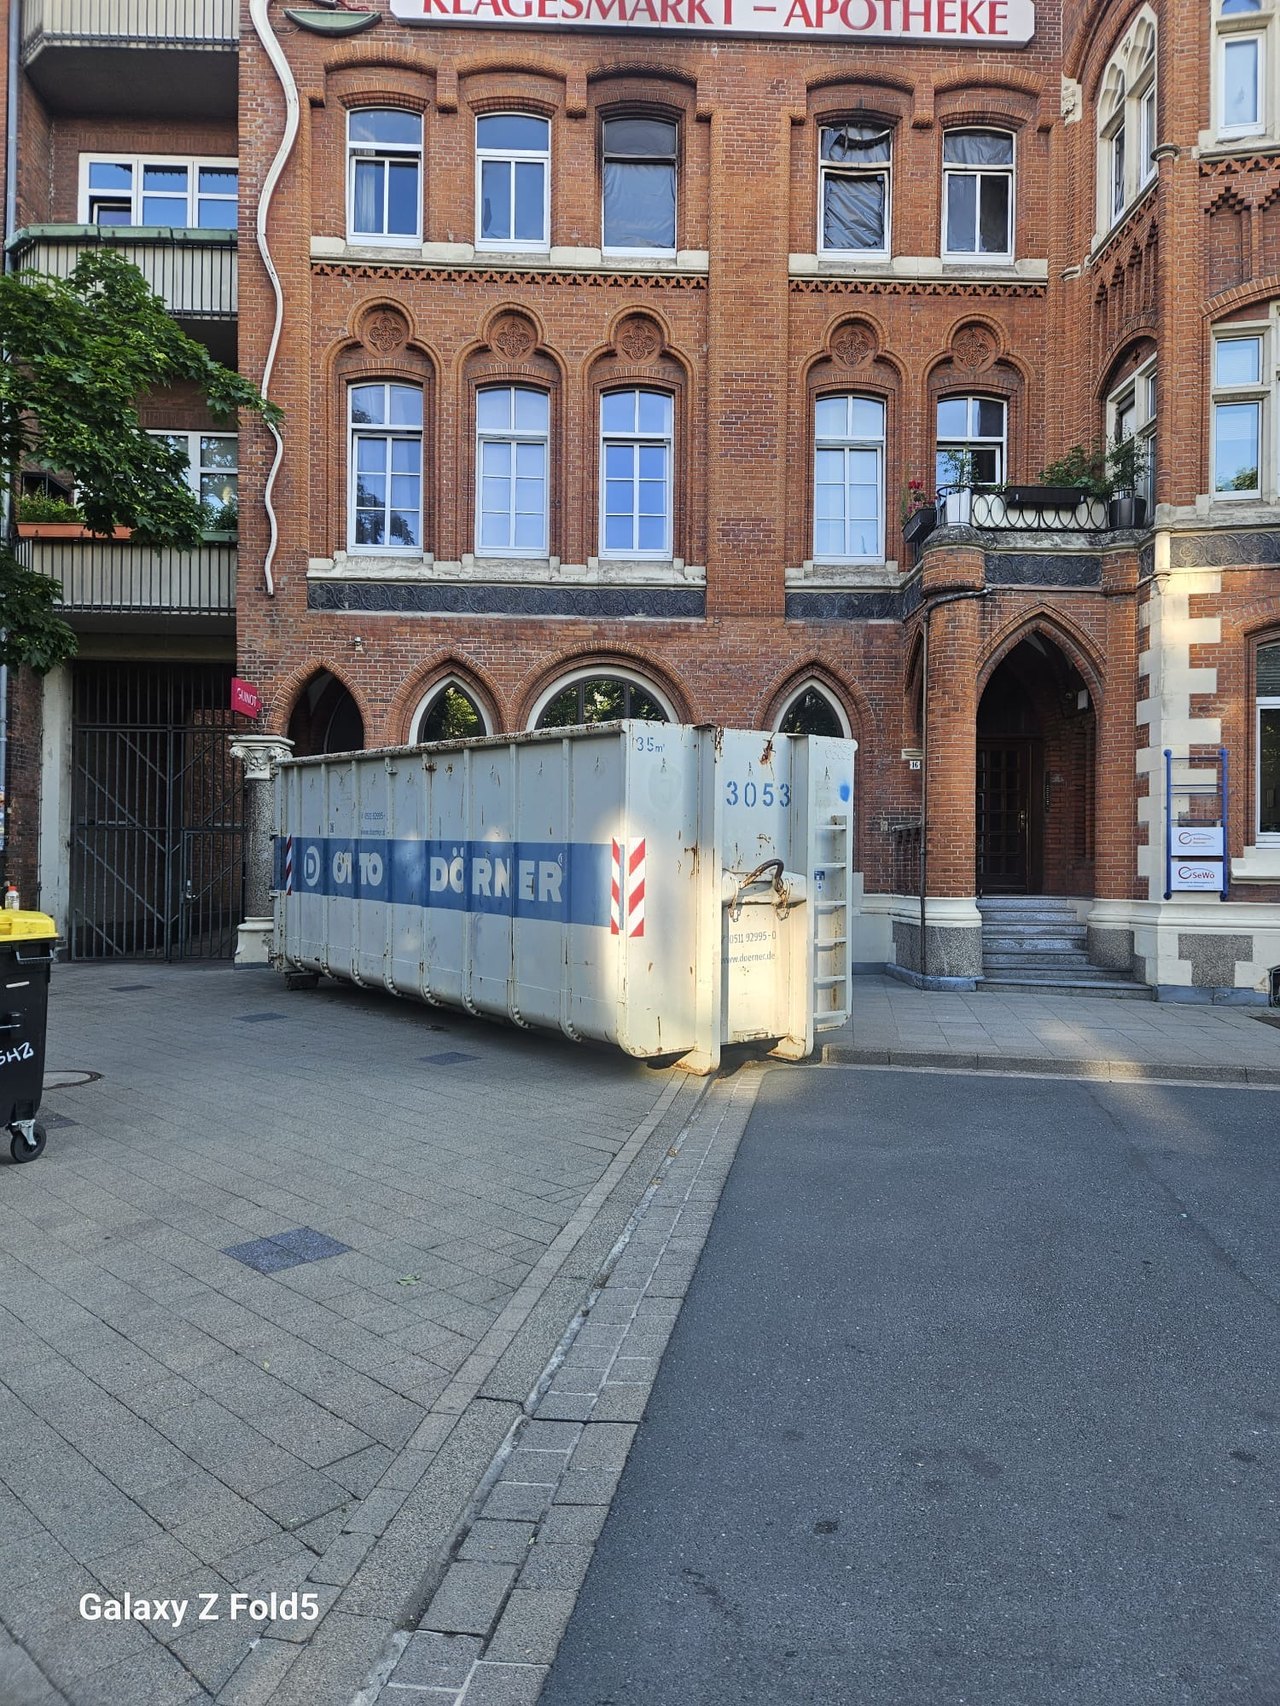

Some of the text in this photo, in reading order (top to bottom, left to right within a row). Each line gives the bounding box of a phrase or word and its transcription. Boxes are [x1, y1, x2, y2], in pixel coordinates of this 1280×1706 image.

[783, 0, 1009, 35] APOTHEKE
[911, 761, 919, 769] 16
[726, 780, 790, 808] 3053
[333, 851, 383, 887] OTTO
[430, 847, 562, 903] DÖRNER
[745, 930, 777, 943] 92995-0
